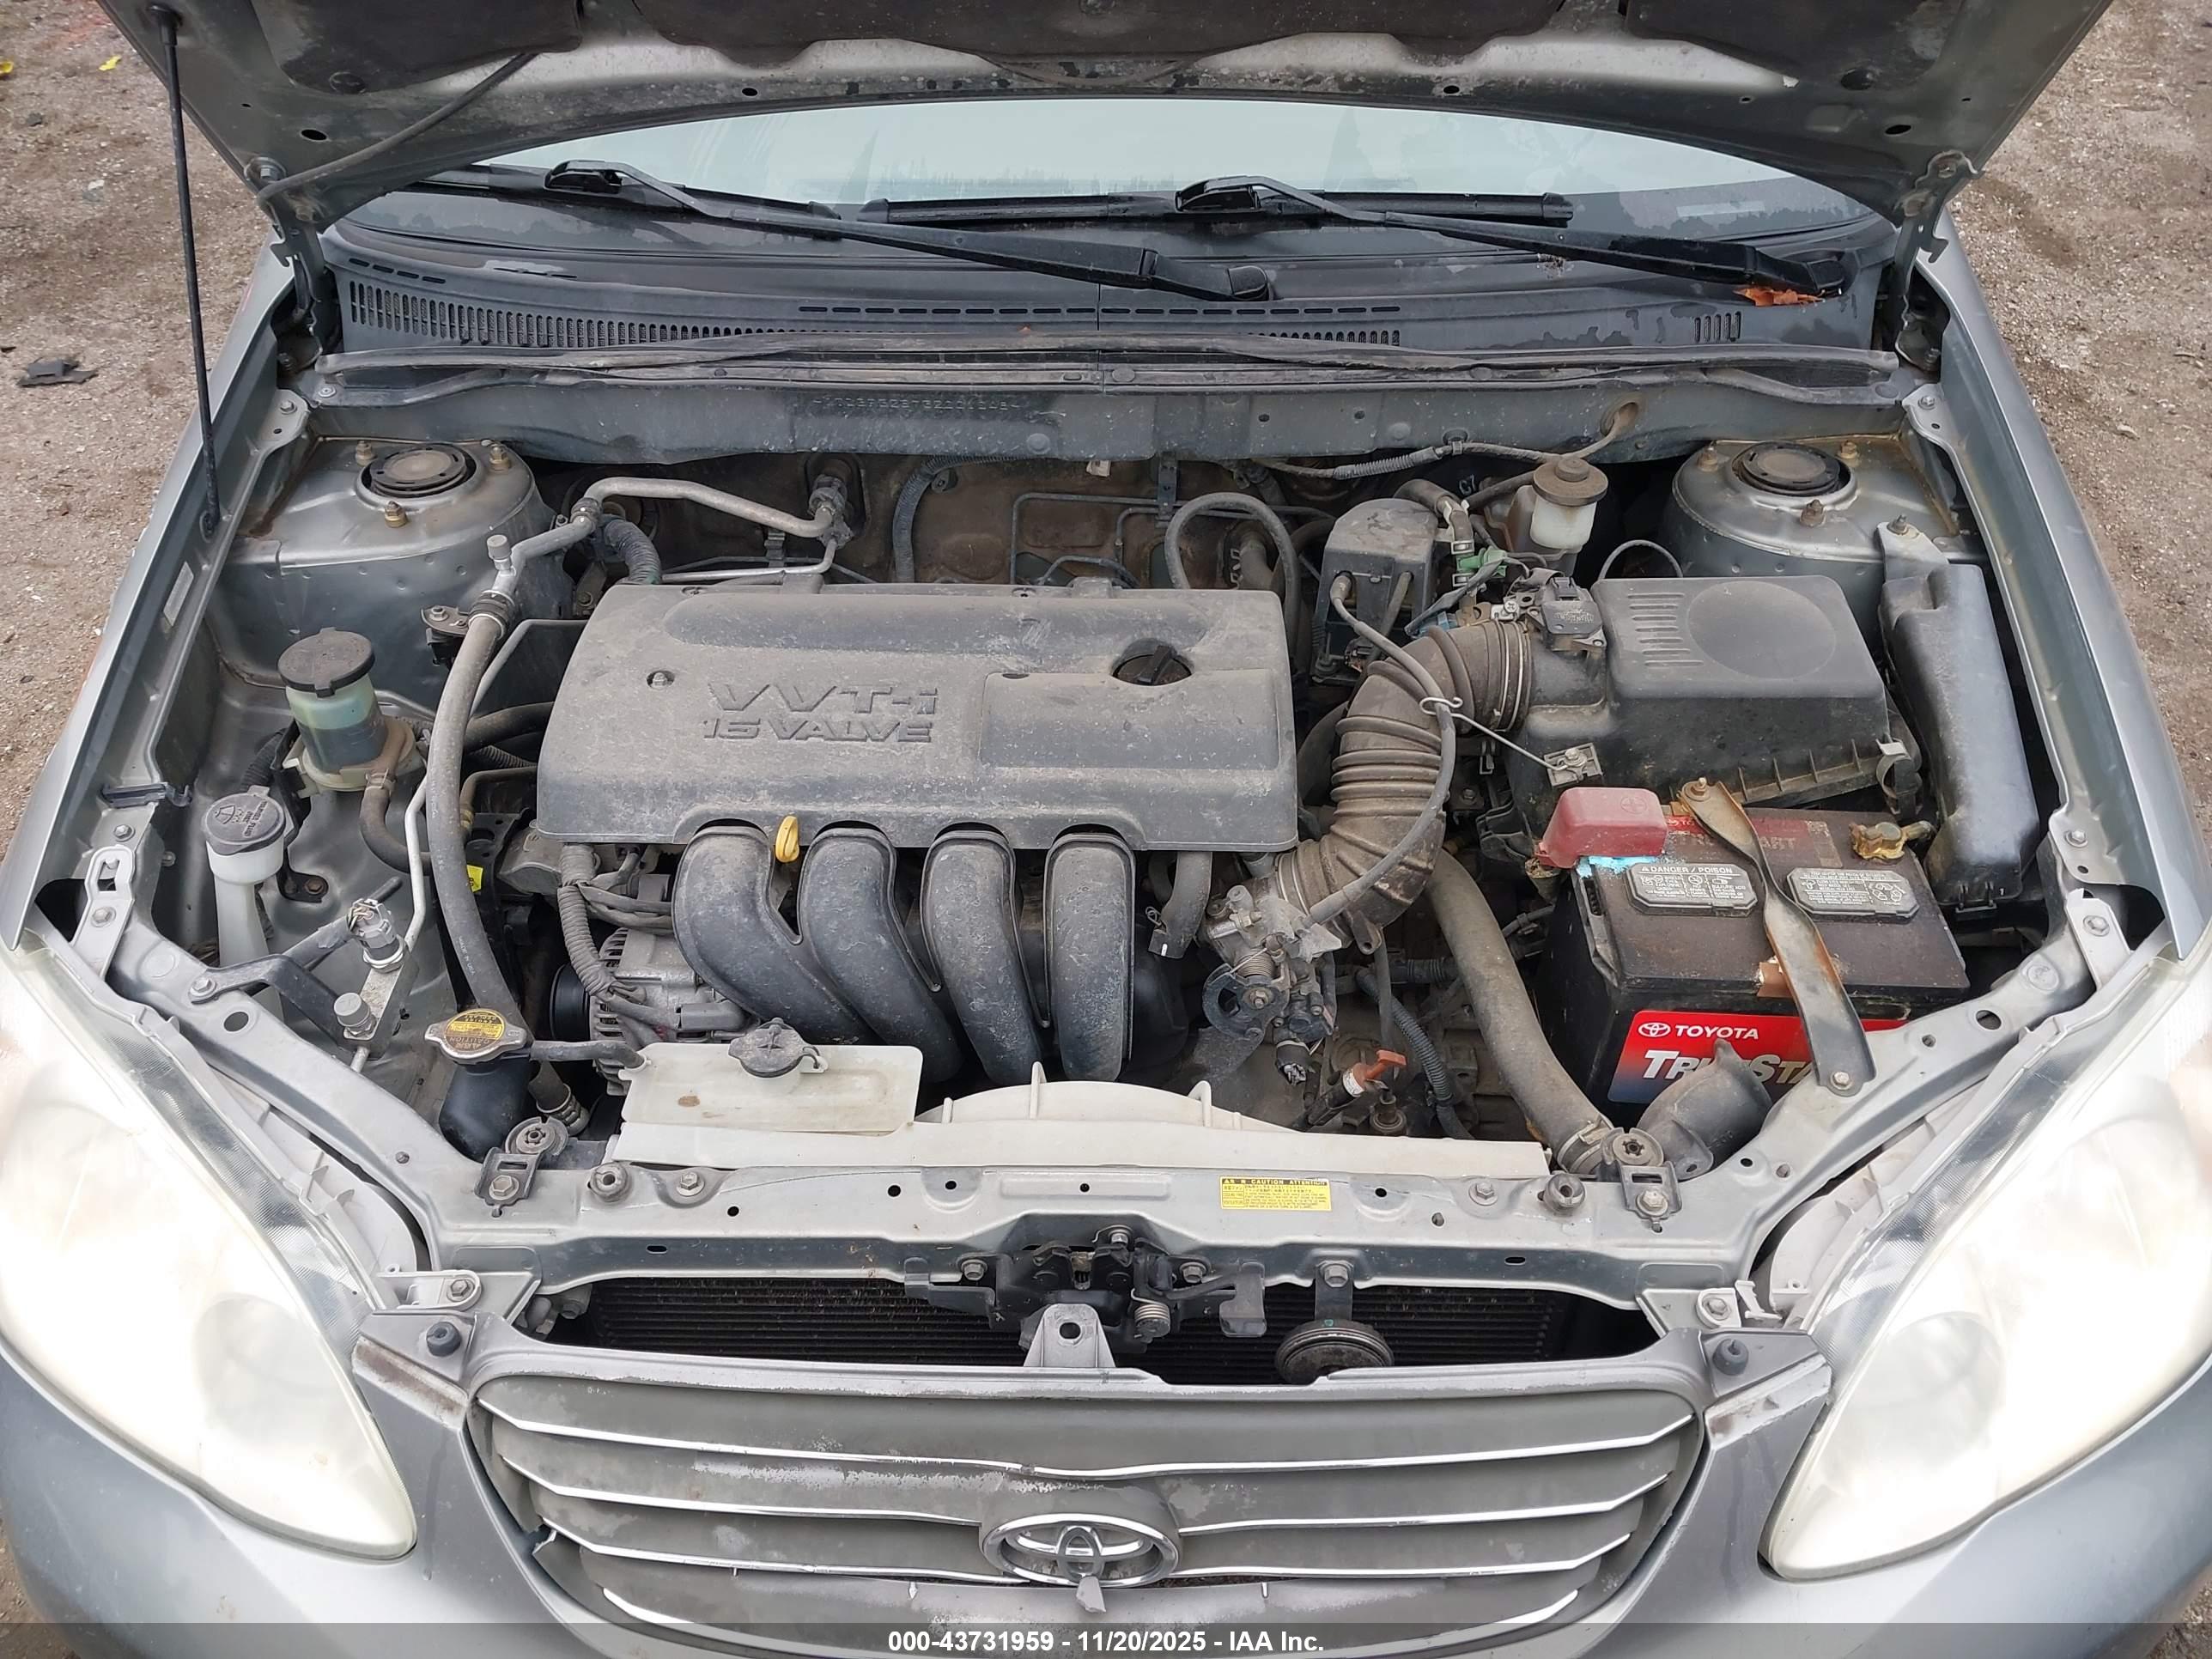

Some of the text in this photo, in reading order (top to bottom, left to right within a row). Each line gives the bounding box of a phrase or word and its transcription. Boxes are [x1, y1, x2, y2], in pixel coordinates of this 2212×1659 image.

[703, 718, 933, 743] 16 VALVE
[1674, 1024, 1759, 1040] TOYOTA
